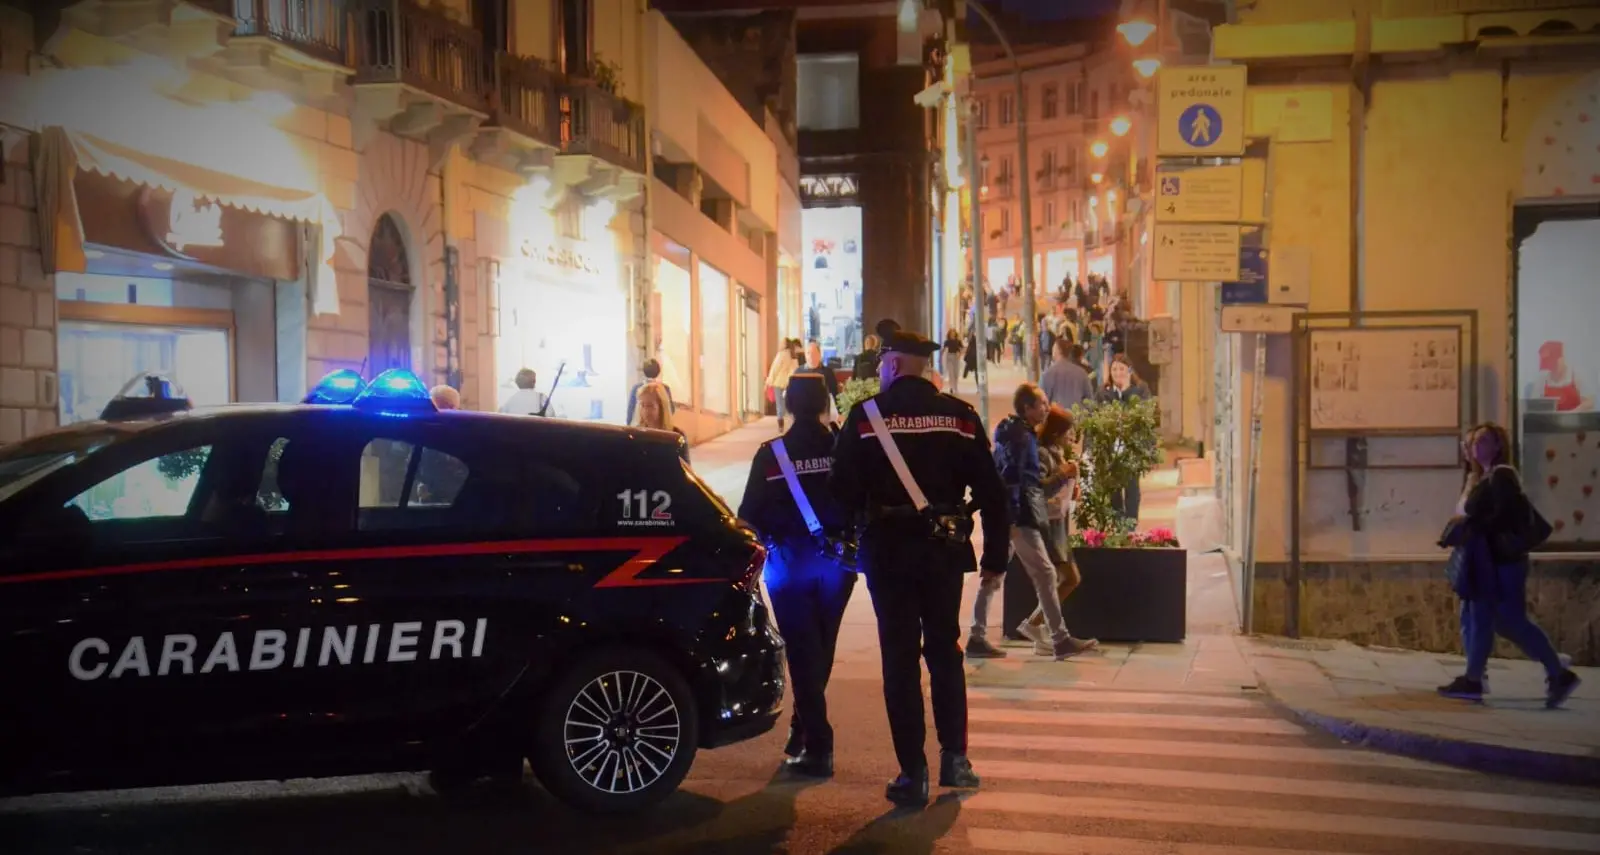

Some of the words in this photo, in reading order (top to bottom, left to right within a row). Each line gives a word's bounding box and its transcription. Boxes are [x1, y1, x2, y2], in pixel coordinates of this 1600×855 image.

[1187, 74, 1216, 83] area
[1171, 87, 1232, 98] pedonale
[883, 414, 957, 429] CARABINIERI
[794, 456, 834, 471] RABIN
[616, 488, 672, 519] 112
[68, 617, 488, 681] CARABINIERI
